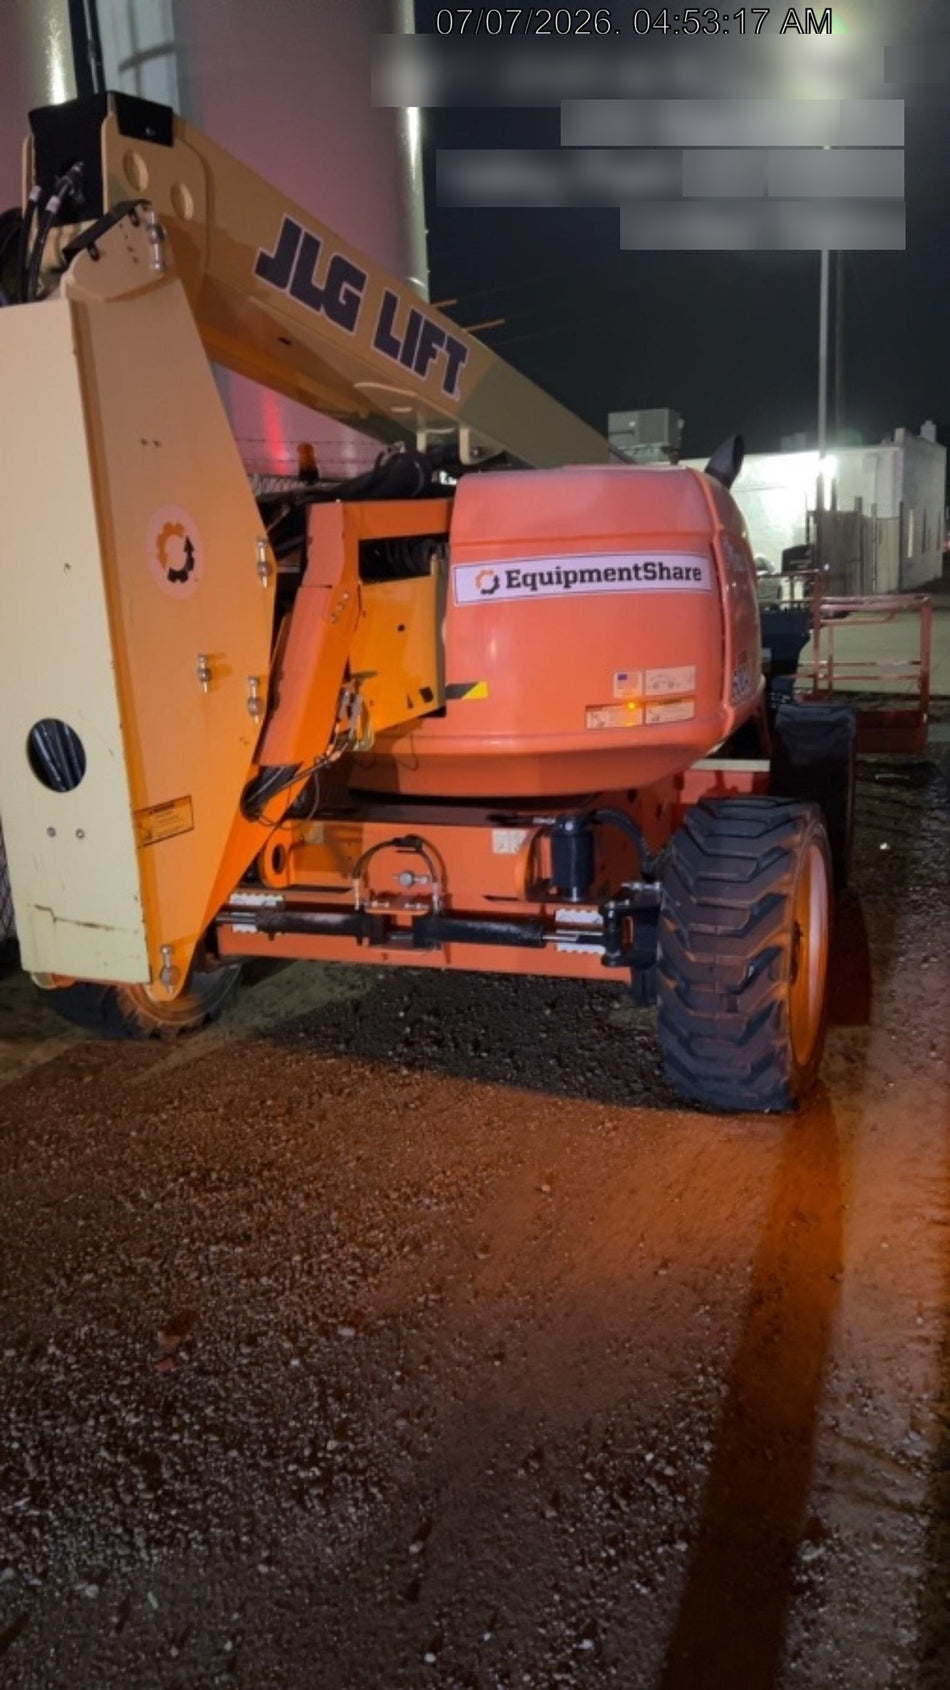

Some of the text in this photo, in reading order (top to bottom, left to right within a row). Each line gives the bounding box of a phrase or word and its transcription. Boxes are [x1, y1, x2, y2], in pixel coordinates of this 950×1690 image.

[254, 213, 469, 400] JLG LIFT
[504, 561, 702, 591] EquipmentShare
